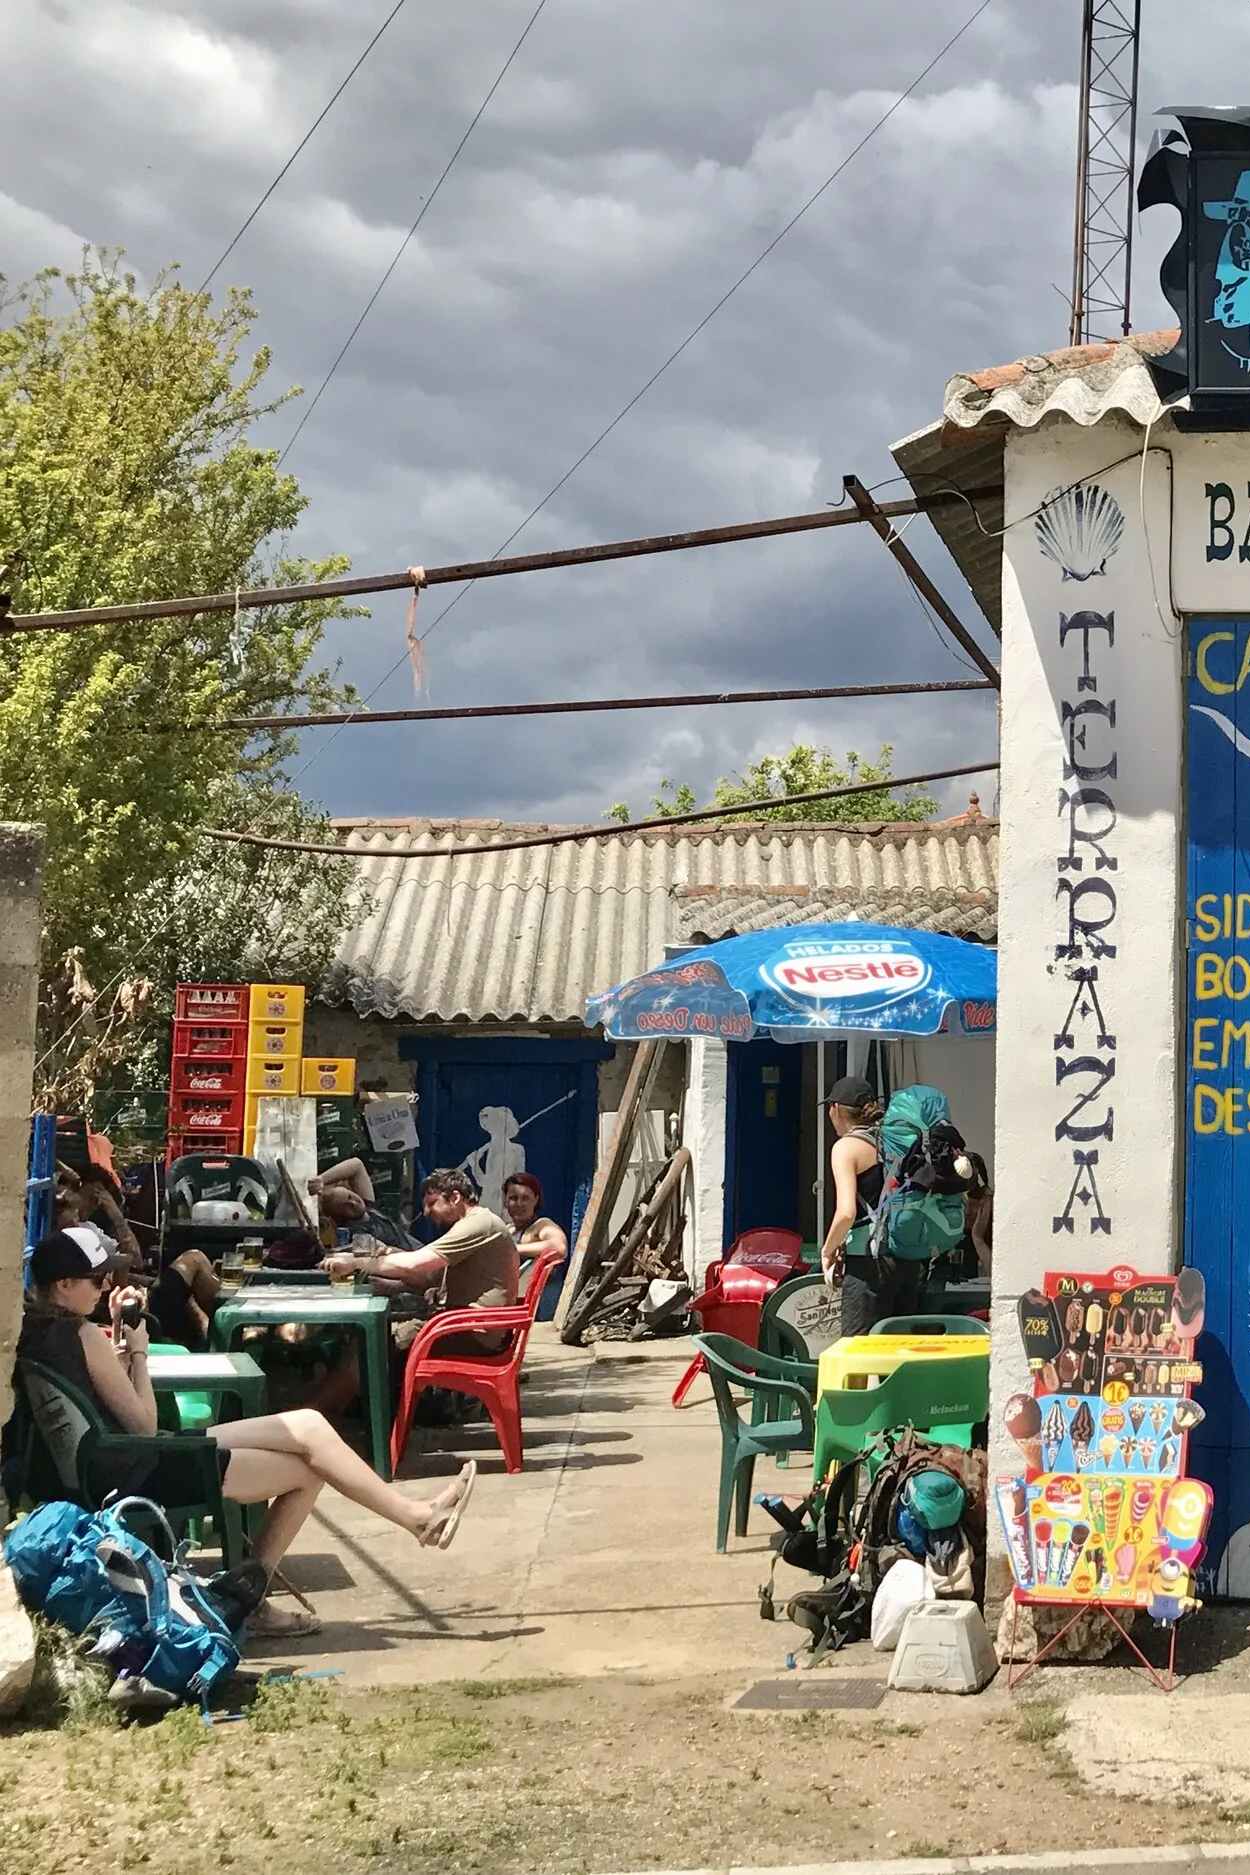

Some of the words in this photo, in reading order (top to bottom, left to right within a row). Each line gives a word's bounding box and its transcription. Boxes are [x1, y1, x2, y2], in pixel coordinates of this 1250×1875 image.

[1052, 610, 1118, 1234] TERRAZA
[787, 942, 894, 958] HELADOS
[1024, 1318, 1049, 1331] 70%
[1107, 1382, 1126, 1403] 1€
[1126, 1527, 1143, 1543] 1€
